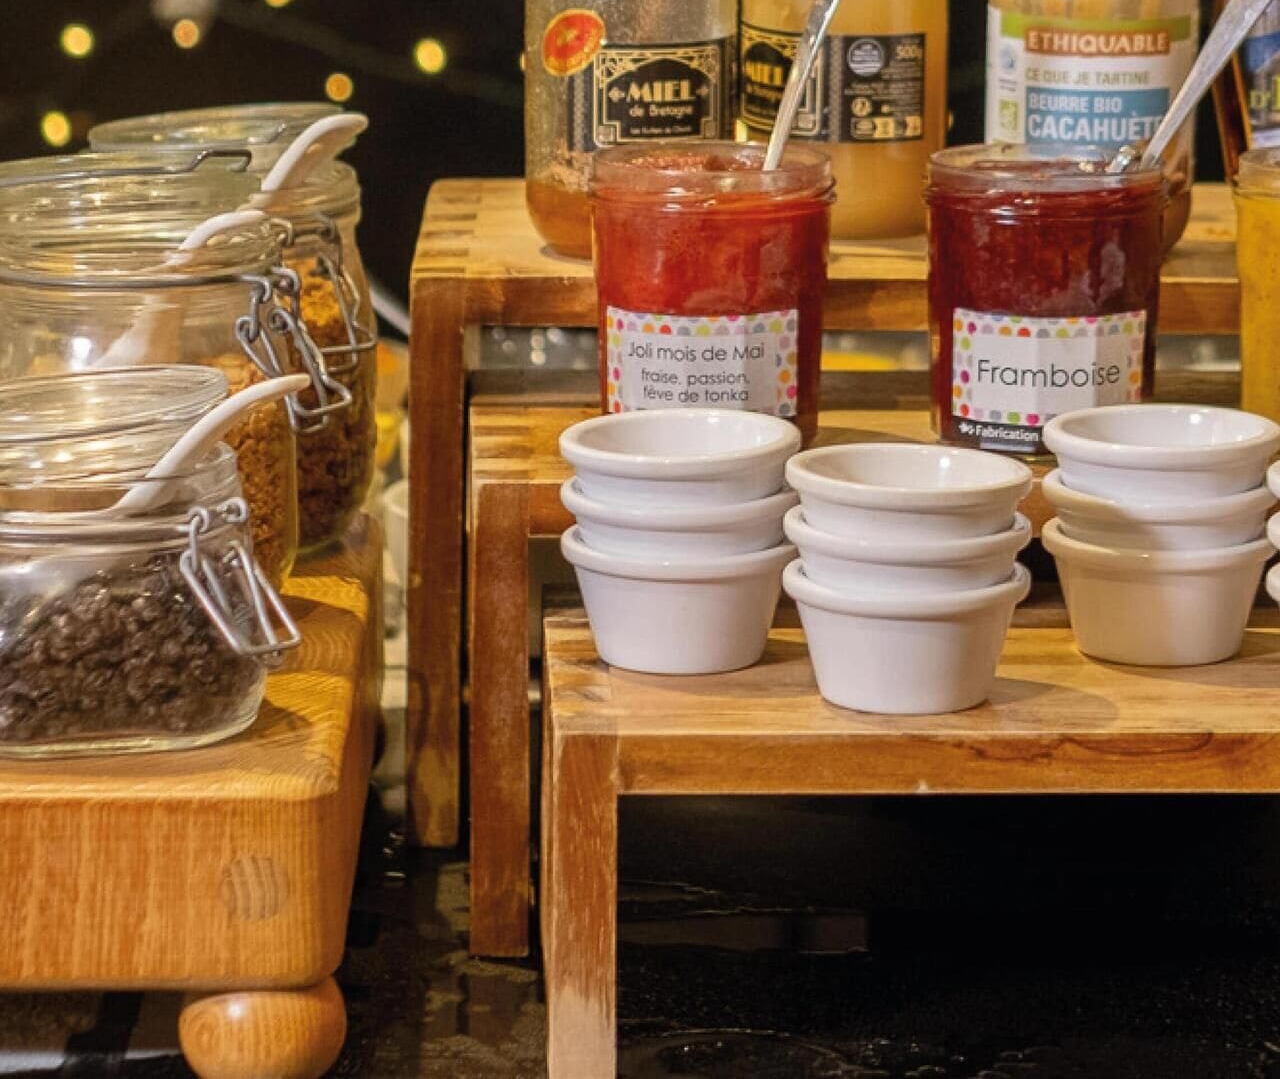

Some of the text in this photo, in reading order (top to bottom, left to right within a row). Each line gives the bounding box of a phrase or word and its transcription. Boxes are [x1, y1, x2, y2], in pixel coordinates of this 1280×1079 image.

[1028, 30, 1168, 53] ETHIQUABLE
[1026, 68, 1151, 85] CE QUE JE TARTINE
[626, 80, 696, 102] MIEL
[1029, 93, 1122, 113] BEURRE BIO
[627, 342, 765, 362] Joli mois de Mai
[977, 359, 1120, 388] Framboise
[643, 386, 749, 403] fève de tonka
[975, 424, 1039, 442] Fabrication
